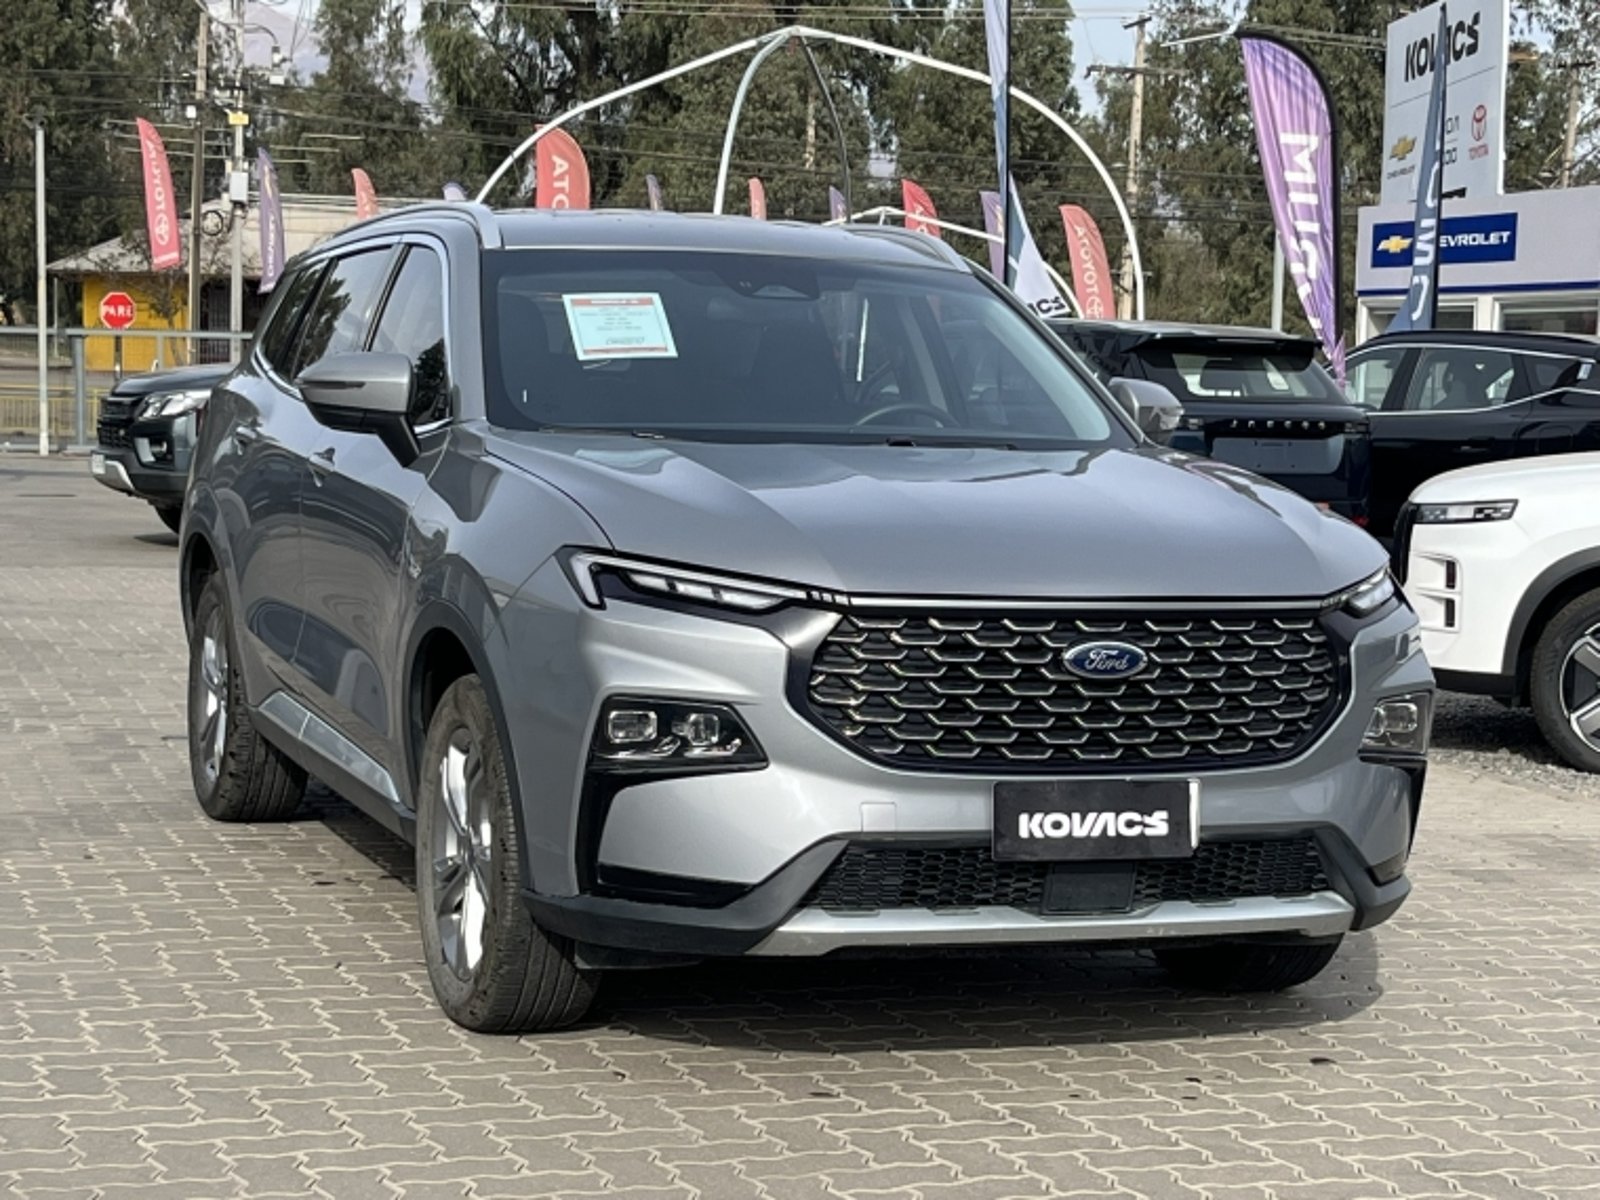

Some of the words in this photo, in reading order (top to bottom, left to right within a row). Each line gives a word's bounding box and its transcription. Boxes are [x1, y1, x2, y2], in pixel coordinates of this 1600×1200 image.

[1440, 231, 1511, 248] EVROLET
[1084, 648, 1131, 670] Ford
[1018, 811, 1169, 839] KOVACS
